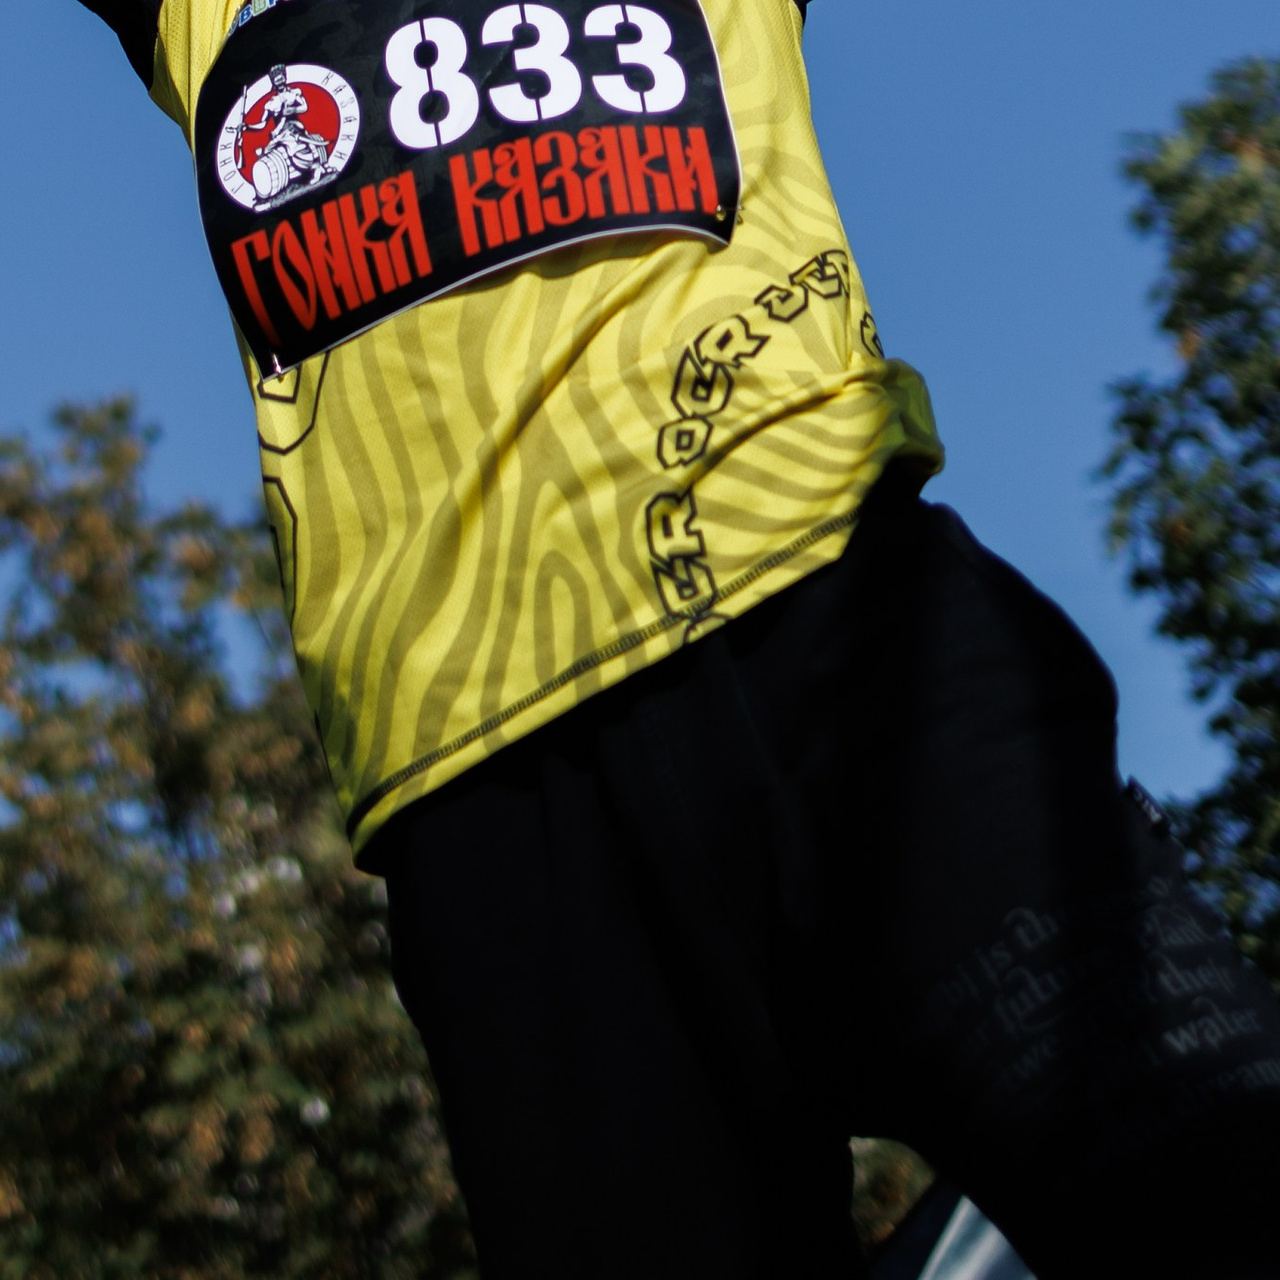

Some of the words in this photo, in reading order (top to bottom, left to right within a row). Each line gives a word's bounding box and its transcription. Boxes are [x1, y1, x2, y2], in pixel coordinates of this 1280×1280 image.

[384, 3, 687, 151] 833
[230, 170, 434, 348] ГОНКА
[449, 124, 718, 258] КАЗАКИ
